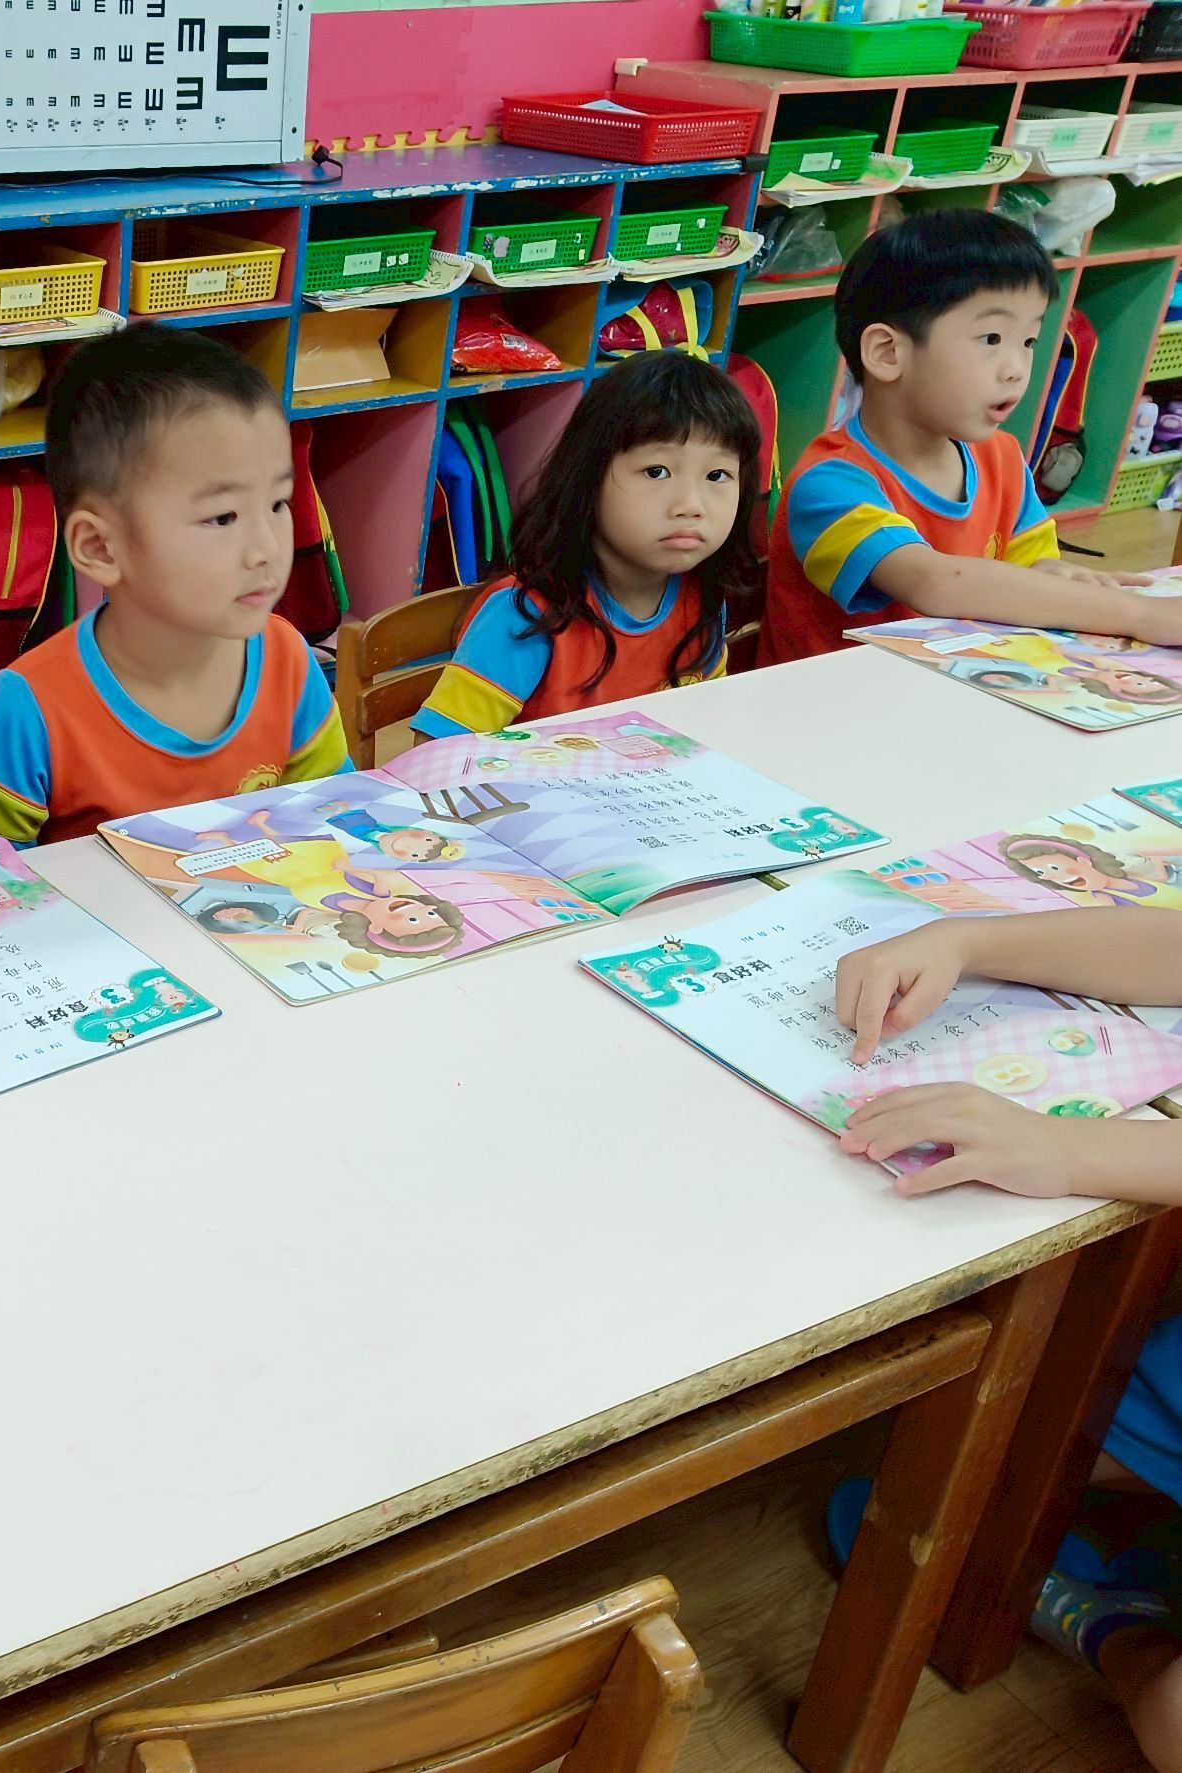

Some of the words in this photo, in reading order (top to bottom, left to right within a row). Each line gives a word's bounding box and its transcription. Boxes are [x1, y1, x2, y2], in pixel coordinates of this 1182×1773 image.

[712, 959, 773, 984] 食好料
[24, 1000, 88, 1029] 食好料
